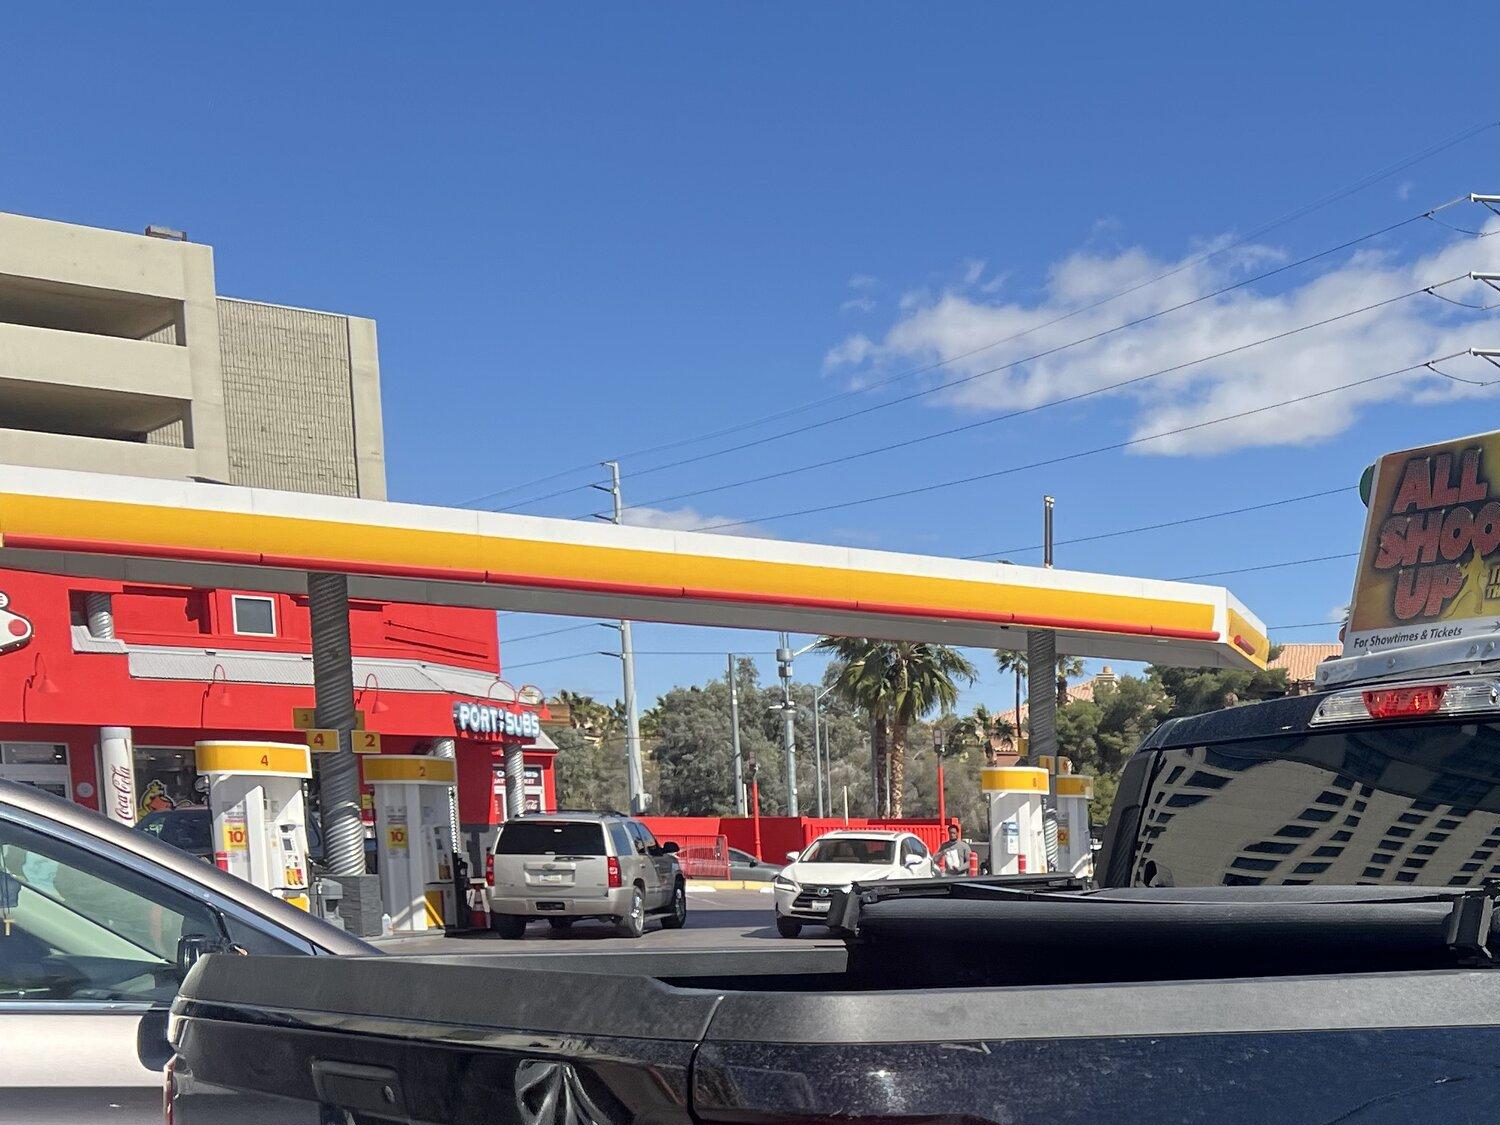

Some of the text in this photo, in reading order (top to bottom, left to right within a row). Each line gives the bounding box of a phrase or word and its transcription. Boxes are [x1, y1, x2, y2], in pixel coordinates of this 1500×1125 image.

[1392, 447, 1488, 514] ALL
[1393, 561, 1463, 620] UP
[1354, 626, 1462, 648] For Showtimes & Tickets
[460, 704, 498, 733] PORT
[505, 710, 540, 738] SUBS
[313, 733, 325, 747] 4
[365, 734, 376, 748] 2
[261, 754, 269, 767] 4
[418, 765, 427, 777] 2
